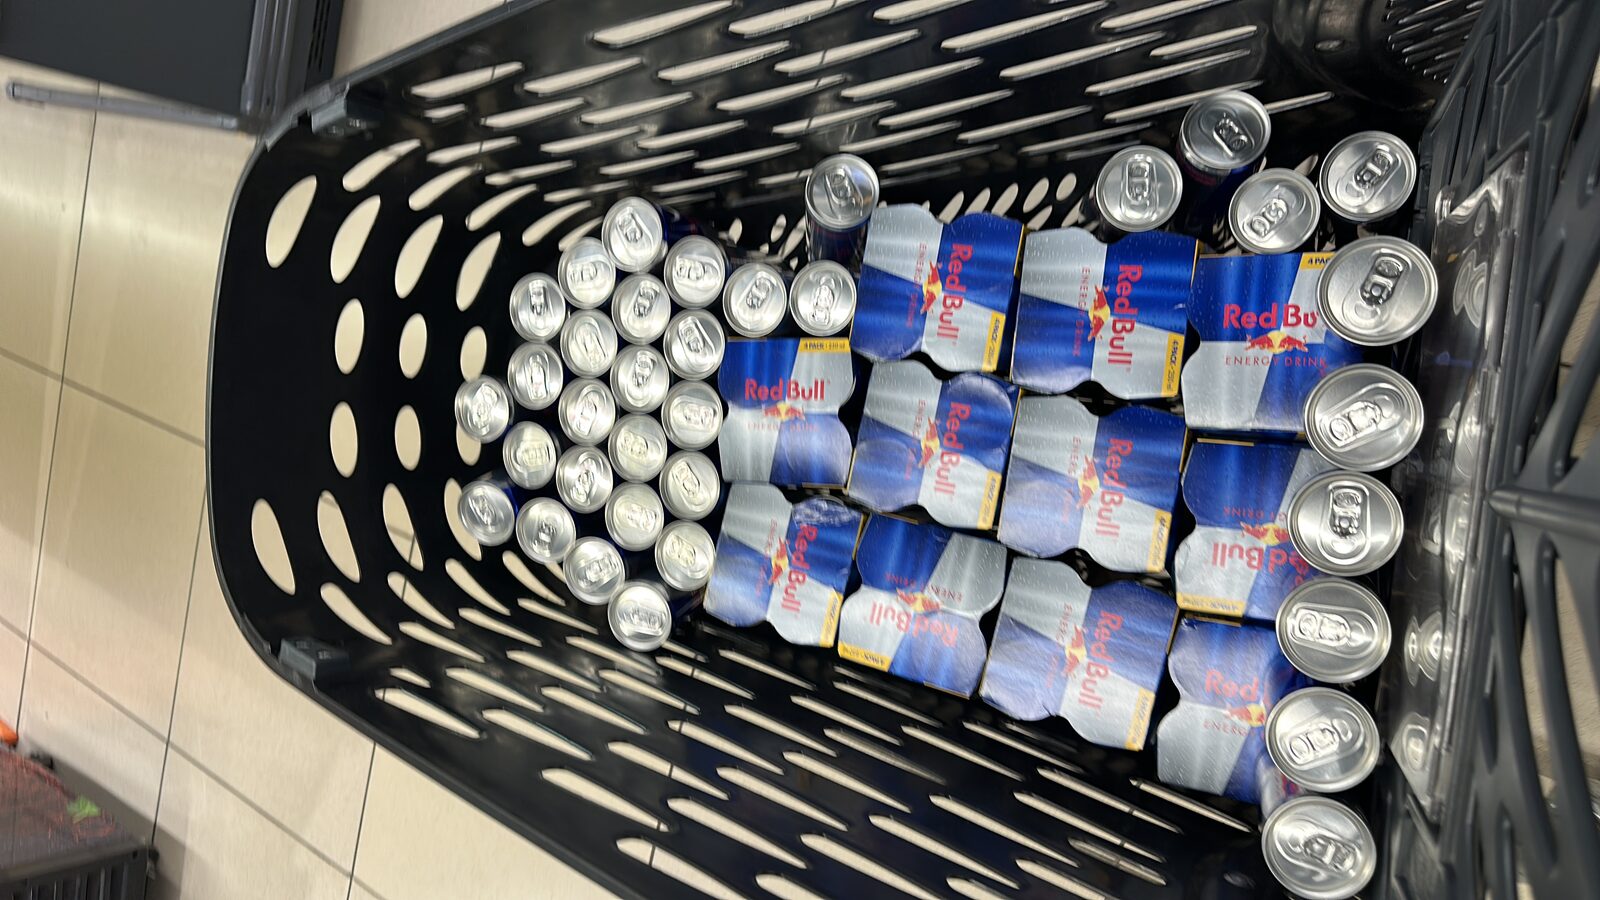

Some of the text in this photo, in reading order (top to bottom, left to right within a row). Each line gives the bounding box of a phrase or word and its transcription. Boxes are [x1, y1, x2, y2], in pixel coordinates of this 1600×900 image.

[937, 243, 973, 340] Red Bull
[1077, 267, 1090, 318] ENERGY
[1108, 264, 1143, 365] Red Bull
[1223, 302, 1319, 329] Red Bu
[1225, 356, 1280, 366] ENERGY
[744, 377, 825, 401] Red Bull
[934, 401, 972, 495] Red Bull
[1095, 438, 1134, 538] Red Bull
[781, 524, 818, 612] Red Bull
[1212, 541, 1265, 570] Bull
[869, 602, 913, 633] Bull
[913, 615, 958, 647] Red
[1078, 610, 1124, 710] Red Bull
[1205, 668, 1259, 701] Red
